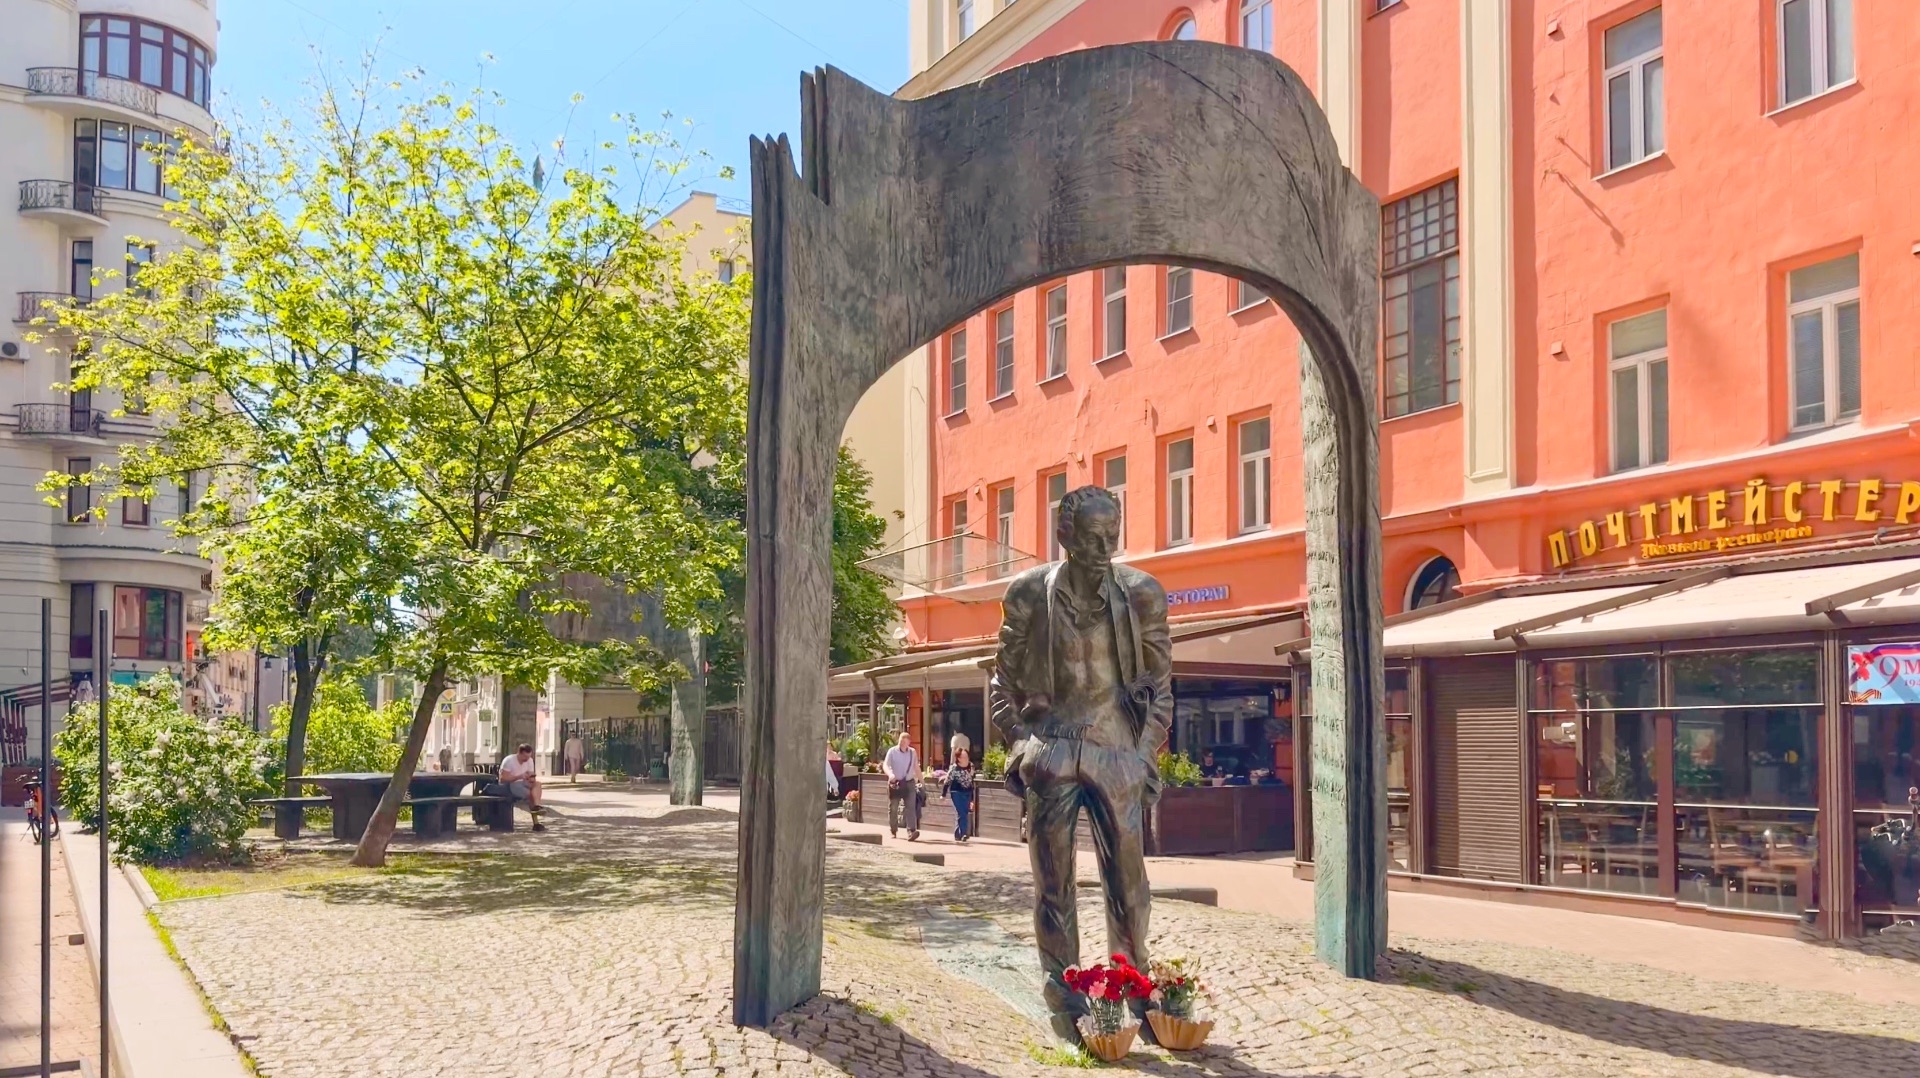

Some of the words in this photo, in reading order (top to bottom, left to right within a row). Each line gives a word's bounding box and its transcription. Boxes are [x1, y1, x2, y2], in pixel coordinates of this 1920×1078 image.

[1548, 478, 1920, 568] ПОЧТМЕЙСТЕР
[1716, 525, 1812, 552] ресторан
[1167, 585, 1230, 606] ЕСТОРАН
[1879, 655, 1900, 688] 9
